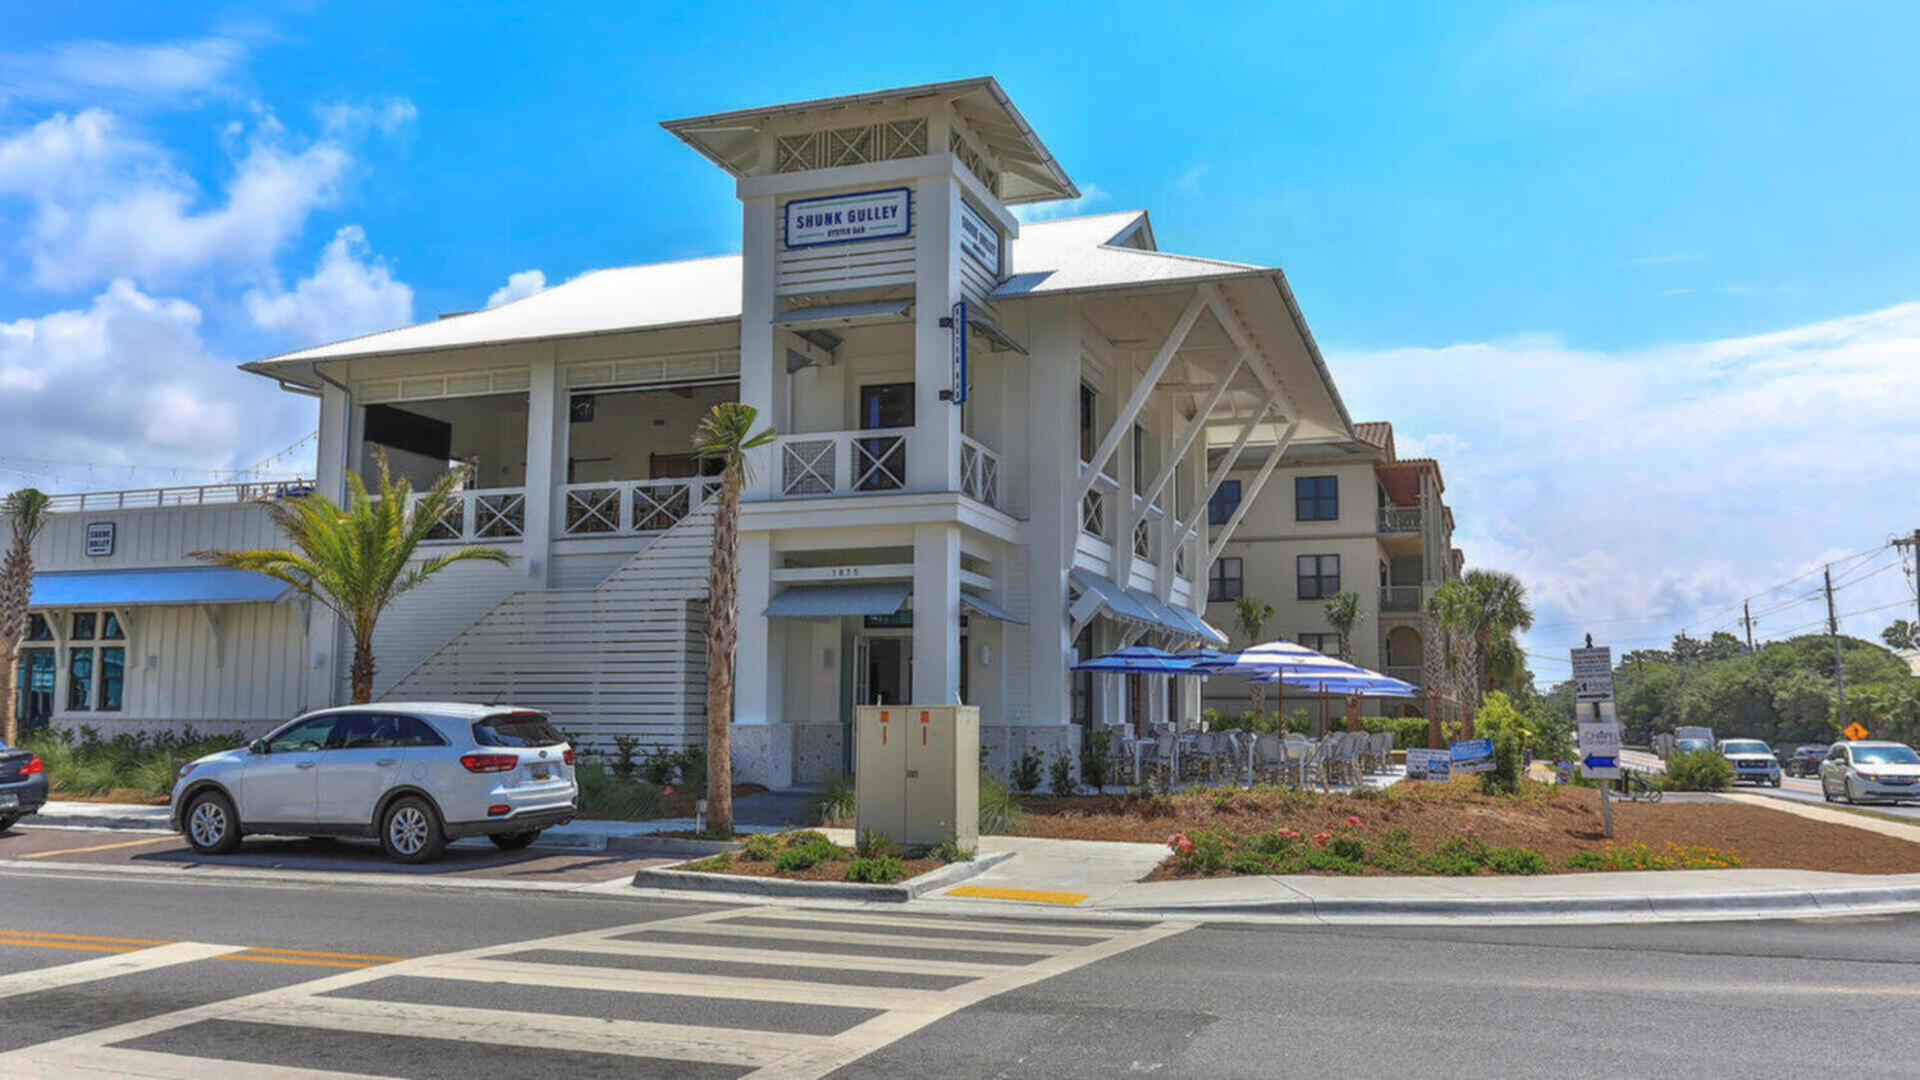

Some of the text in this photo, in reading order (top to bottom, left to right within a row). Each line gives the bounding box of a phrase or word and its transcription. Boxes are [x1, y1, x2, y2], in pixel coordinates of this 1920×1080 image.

[796, 204, 899, 230] SHUNK GULLEY
[852, 225, 866, 235] BAR
